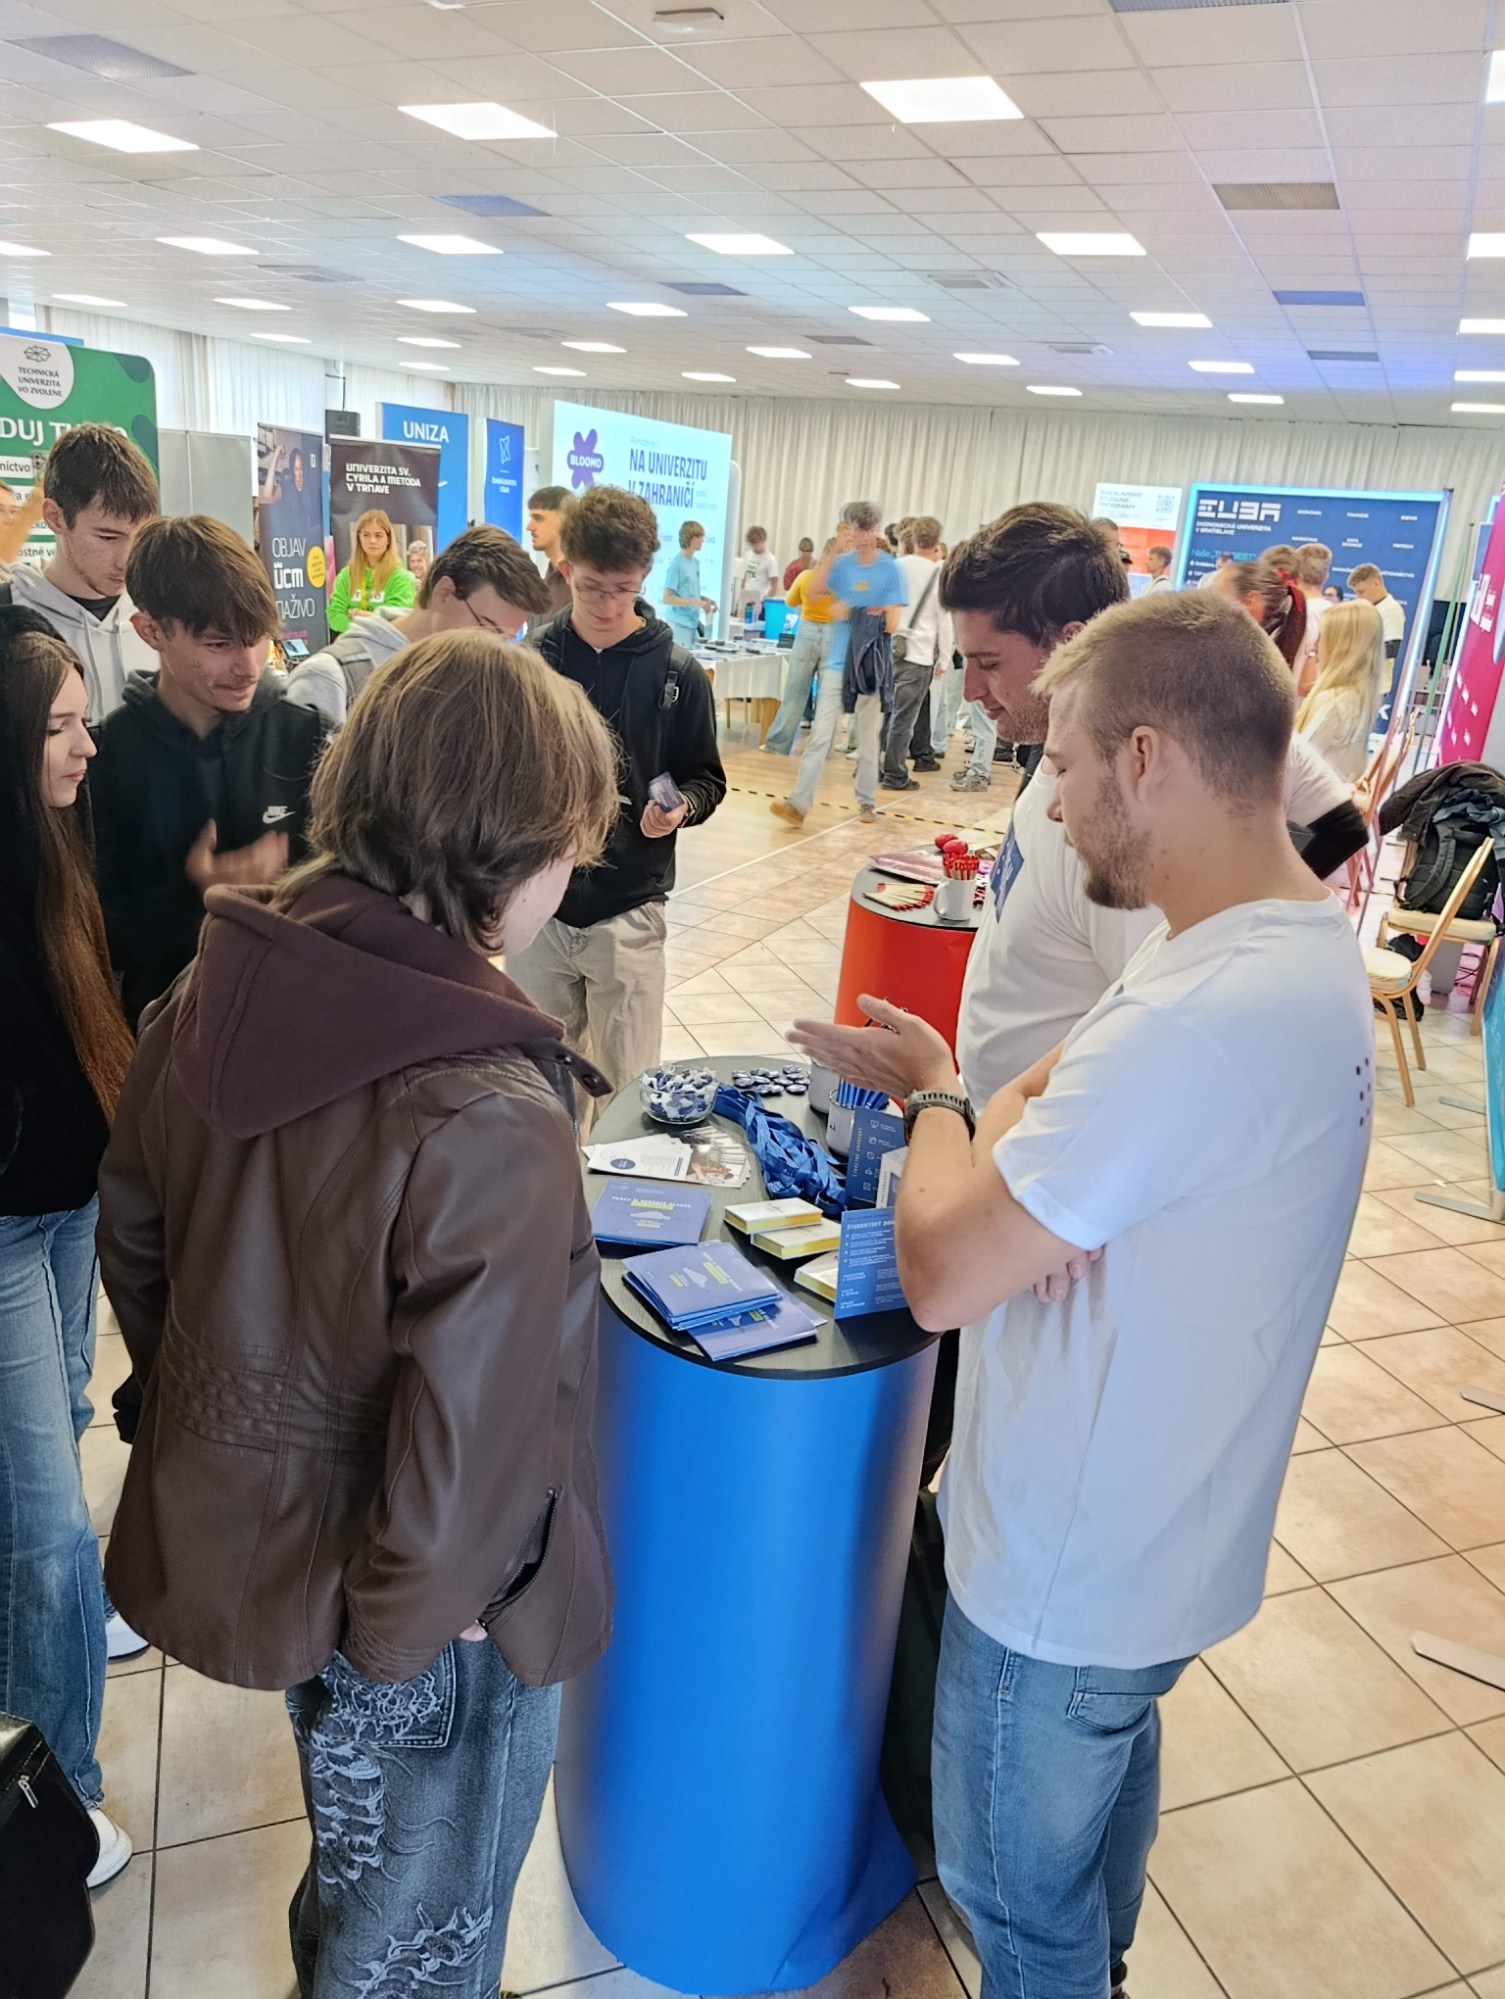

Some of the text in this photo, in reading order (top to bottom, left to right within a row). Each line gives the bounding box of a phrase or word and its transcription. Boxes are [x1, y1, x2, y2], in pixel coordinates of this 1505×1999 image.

[18, 366, 60, 378] TECHNICKÁ
[18, 376, 61, 388] UNIVERZITA
[17, 386, 63, 397] VO ZVOLENE
[403, 420, 450, 443] UNIZA
[569, 454, 602, 469] BLOOMO
[629, 448, 708, 481] NA UNIVERZITU
[345, 462, 411, 477] UNIVERZITA SV.
[345, 472, 421, 488] CYRILA A METODA
[346, 483, 390, 495] V TRNAVE
[638, 480, 696, 509] ZAHRANIČÍ
[1197, 498, 1282, 523] EUBA
[1196, 520, 1272, 532] EKONOMICKÁ UNIVERZITA
[1200, 527, 1236, 536] BRATISLAVE
[272, 537, 306, 558] OBJAV
